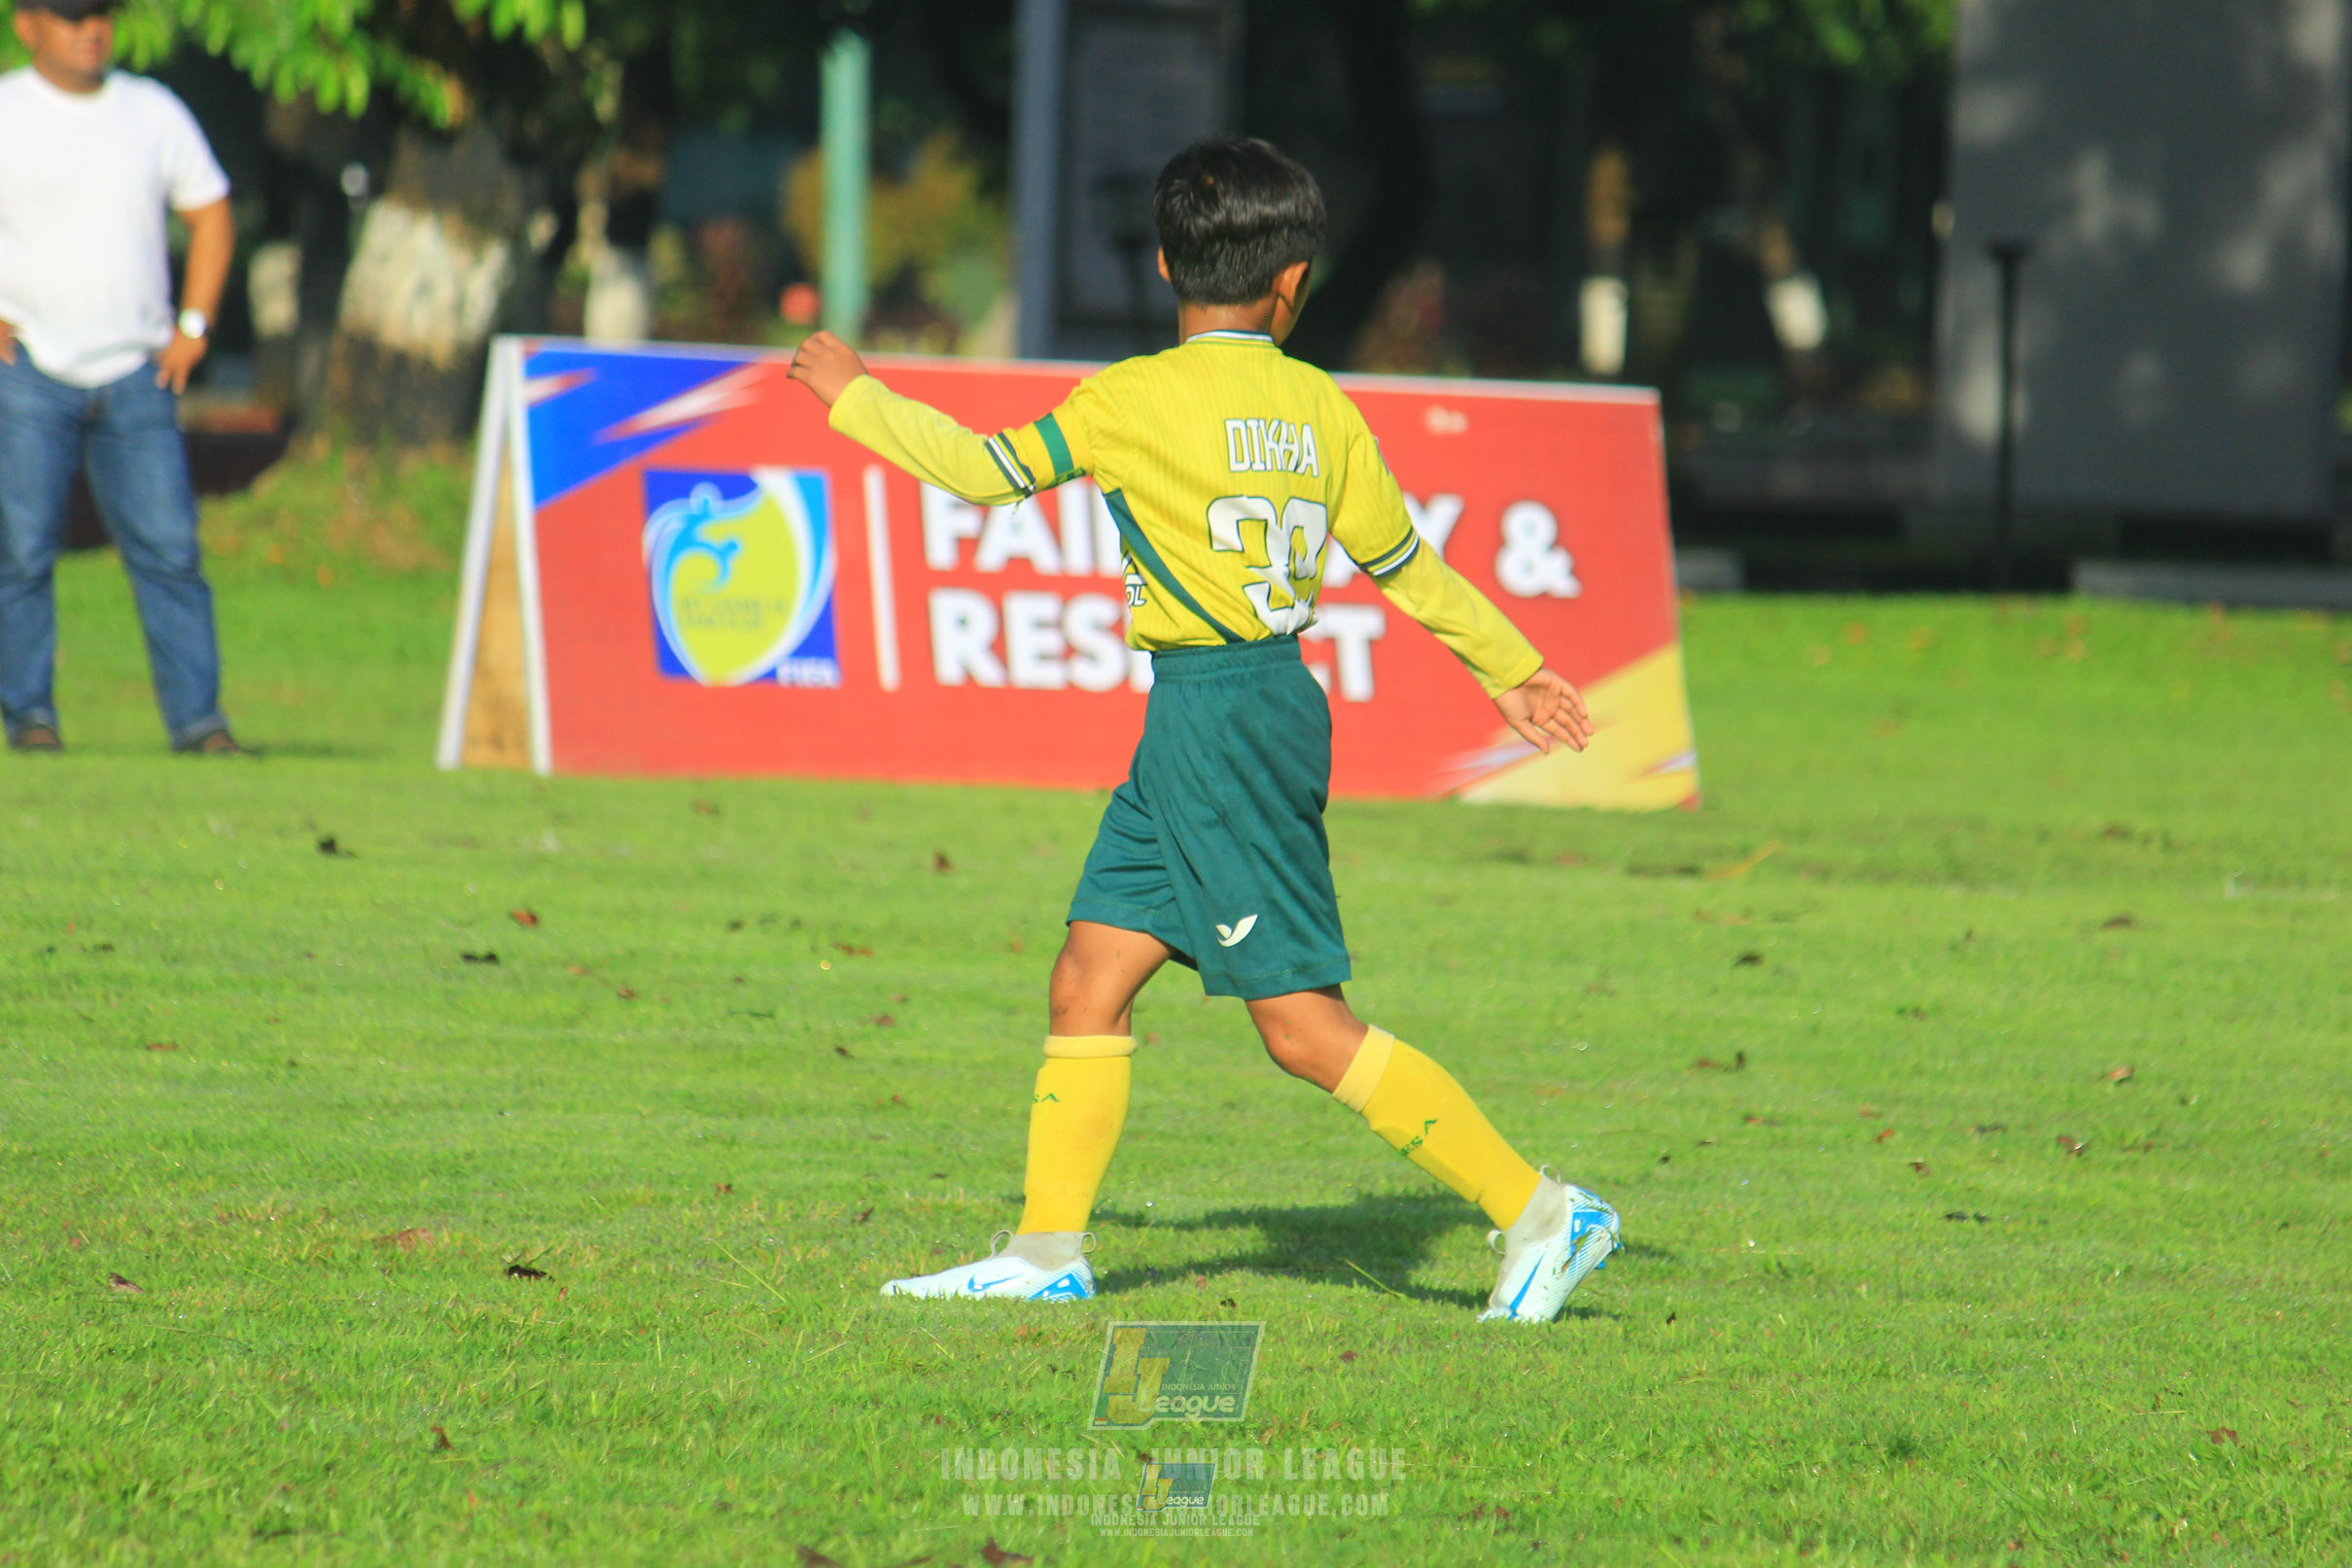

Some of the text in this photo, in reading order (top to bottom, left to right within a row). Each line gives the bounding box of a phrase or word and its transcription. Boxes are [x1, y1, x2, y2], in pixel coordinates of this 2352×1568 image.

[1224, 418, 1319, 477] DIKHA
[1495, 500, 1583, 598] &
[928, 586, 1387, 703] REST
